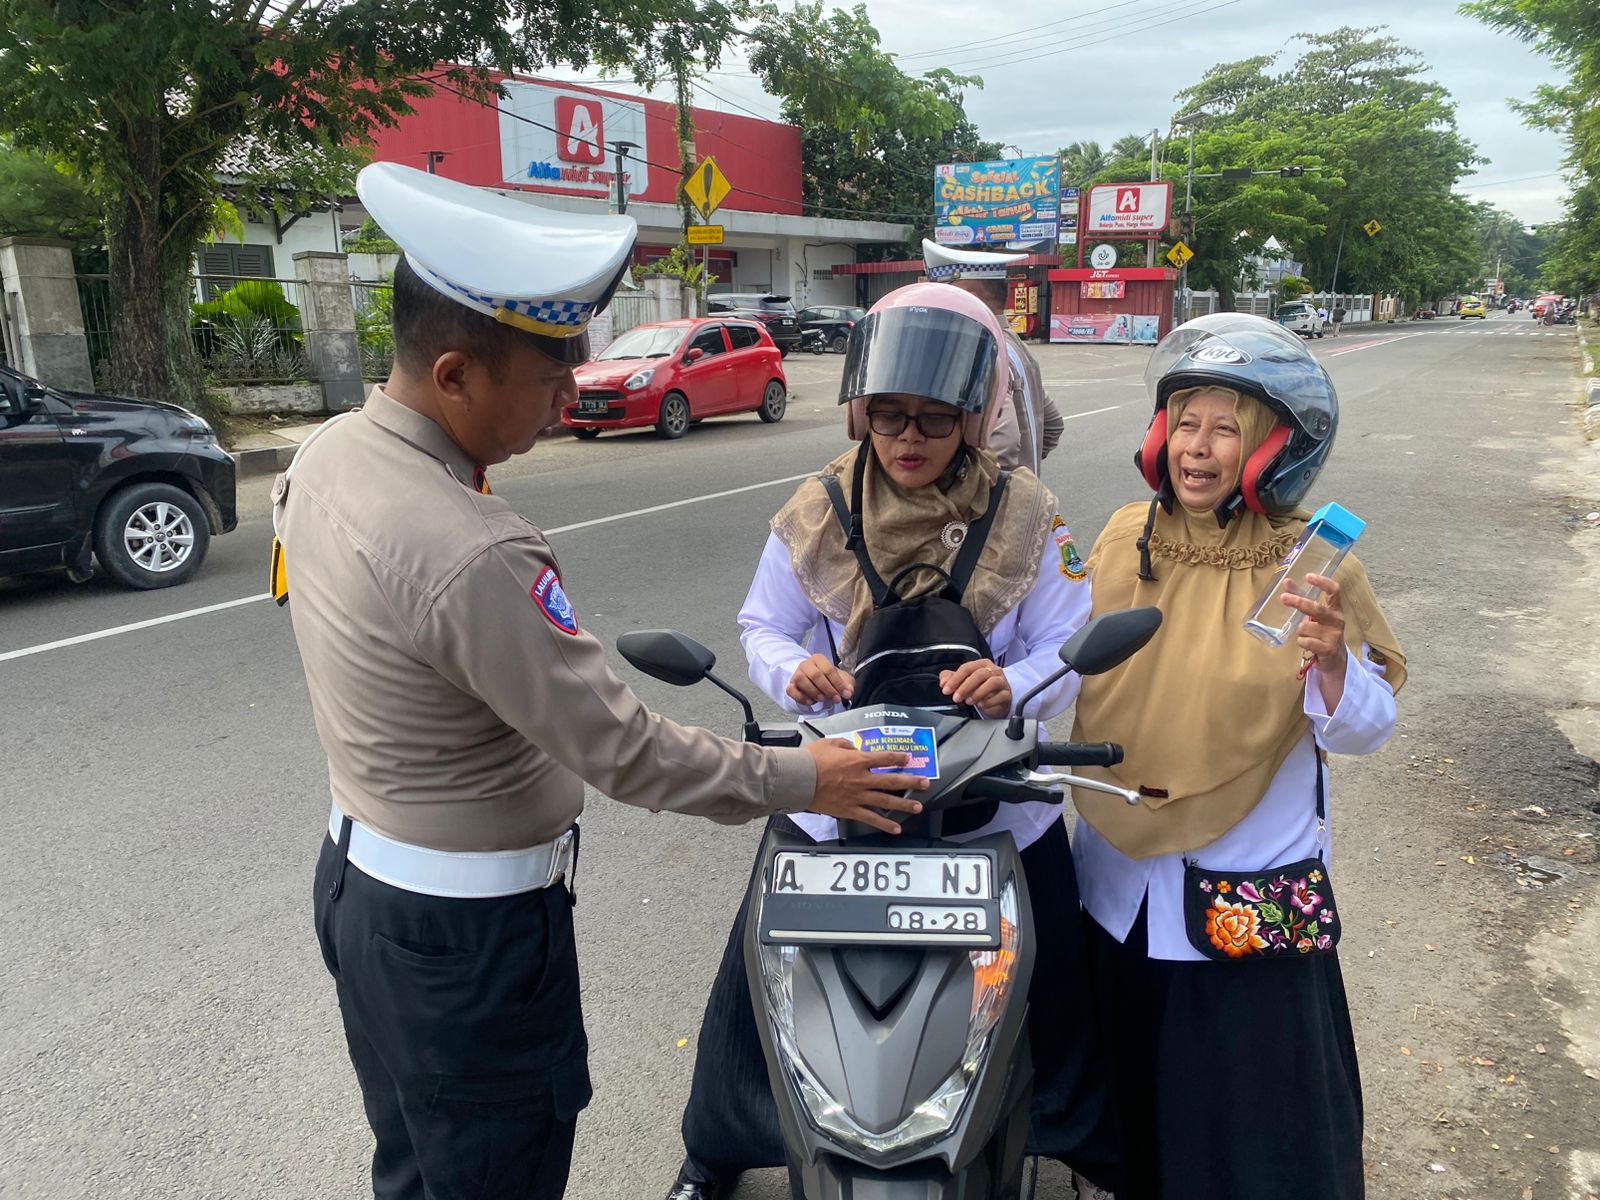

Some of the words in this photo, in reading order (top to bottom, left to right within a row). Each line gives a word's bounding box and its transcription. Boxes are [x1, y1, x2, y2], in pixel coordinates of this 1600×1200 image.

[591, 171, 632, 187] supr
[941, 179, 1051, 202] CASHBACK
[1119, 190, 1137, 211] A
[1132, 213, 1154, 222] super
[1090, 270, 1109, 278] J&T
[864, 711, 909, 719] HONDA
[778, 860, 801, 892] A
[830, 860, 911, 892] 2865
[942, 863, 982, 895] NJ
